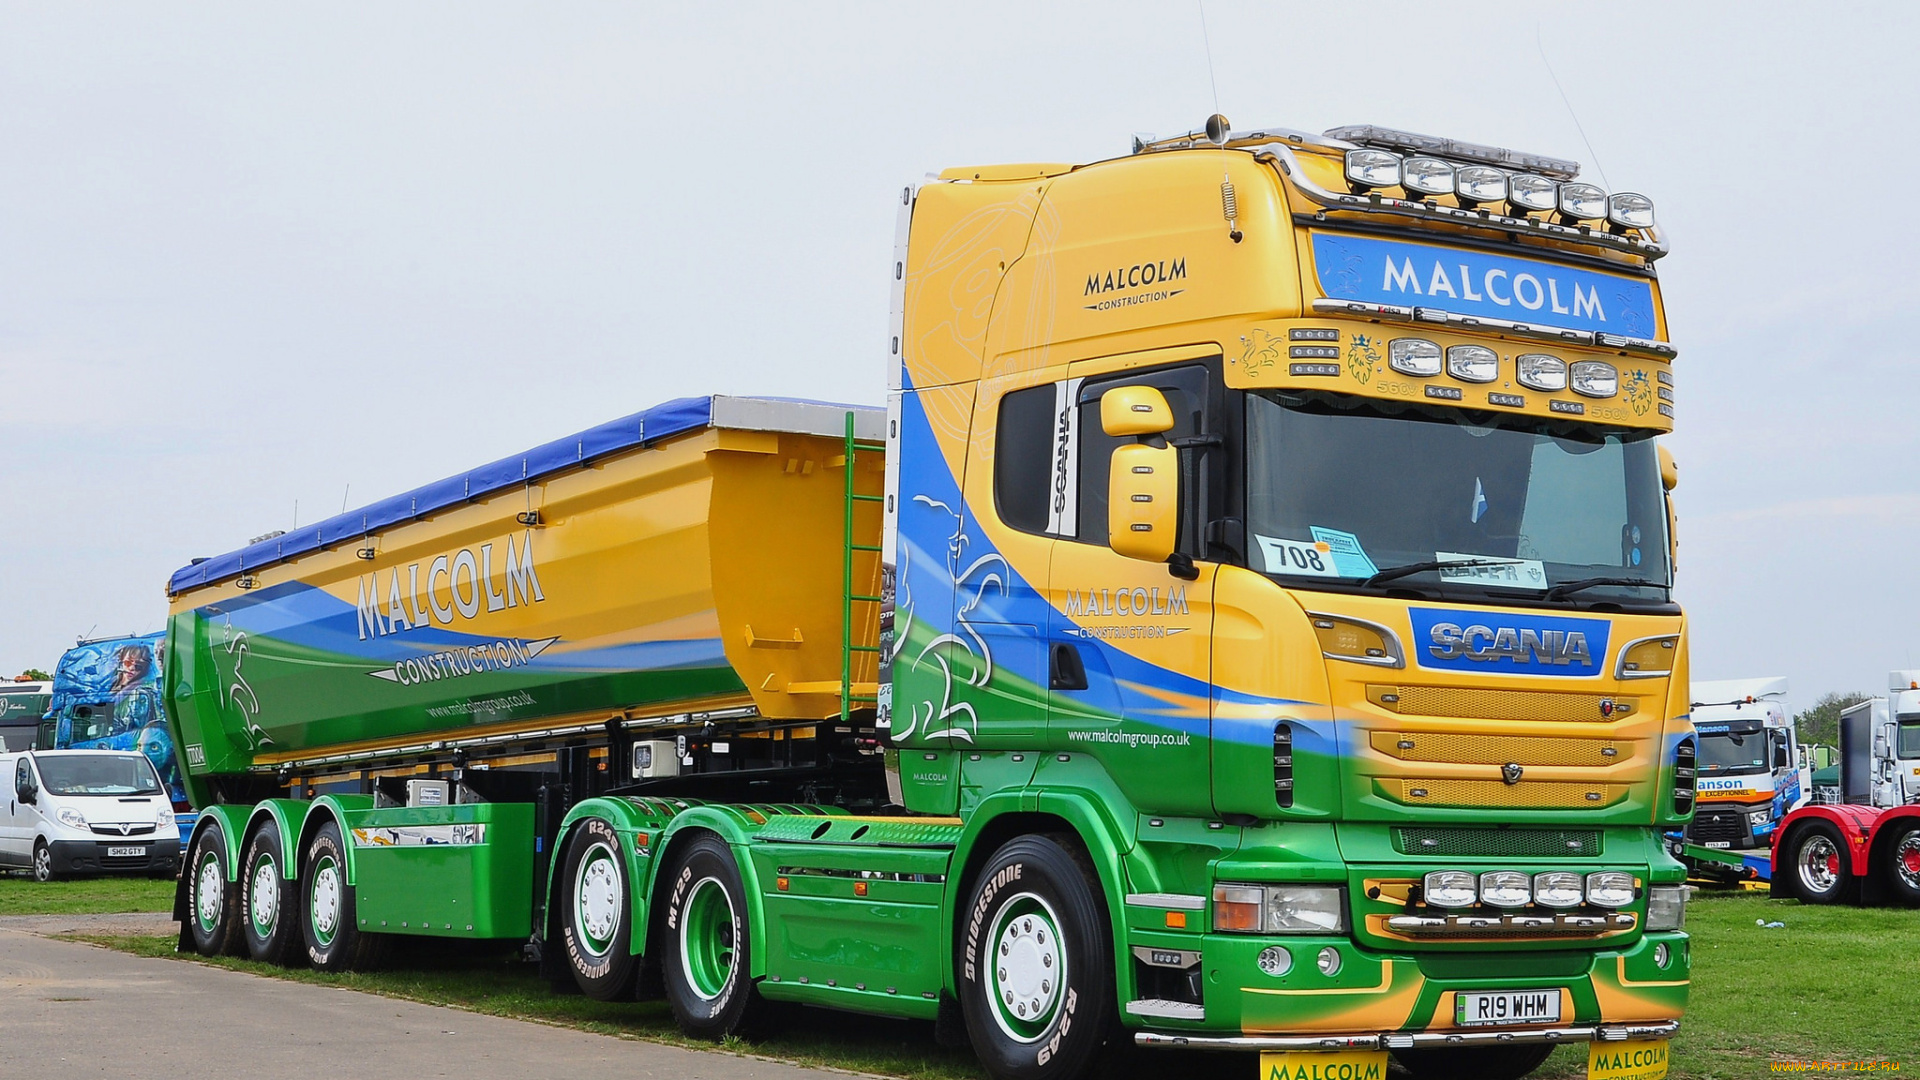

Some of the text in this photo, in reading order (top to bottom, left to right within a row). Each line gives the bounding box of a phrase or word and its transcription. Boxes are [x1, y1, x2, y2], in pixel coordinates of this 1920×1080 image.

[1084, 257, 1187, 296] MALCOLM
[1382, 254, 1606, 322] MALCOLM
[1098, 291, 1168, 311] CONSTRUCTION
[1270, 543, 1325, 571] 708
[357, 529, 545, 641] MALCOLM
[1062, 586, 1189, 617] MALCOLM
[1079, 626, 1165, 639] CONSTRUCTION
[1429, 623, 1593, 666] SCANIA
[395, 638, 528, 686] CONSTRUCTION
[425, 690, 538, 718] www.malcolmgroup.co.uk
[1068, 728, 1190, 748] www.malcolmgroup.co.uk
[913, 773, 948, 781] MALCOLM
[1697, 780, 1743, 790] anson
[1705, 789, 1750, 798] EXCEPTIONNEL
[965, 863, 1023, 983] BRIDGESTONE
[1479, 994, 1547, 1018] R19 WHM
[1037, 986, 1078, 1067] R249
[1270, 1063, 1380, 1080] MALCOLM
[1595, 1046, 1666, 1071] MALCOLM
